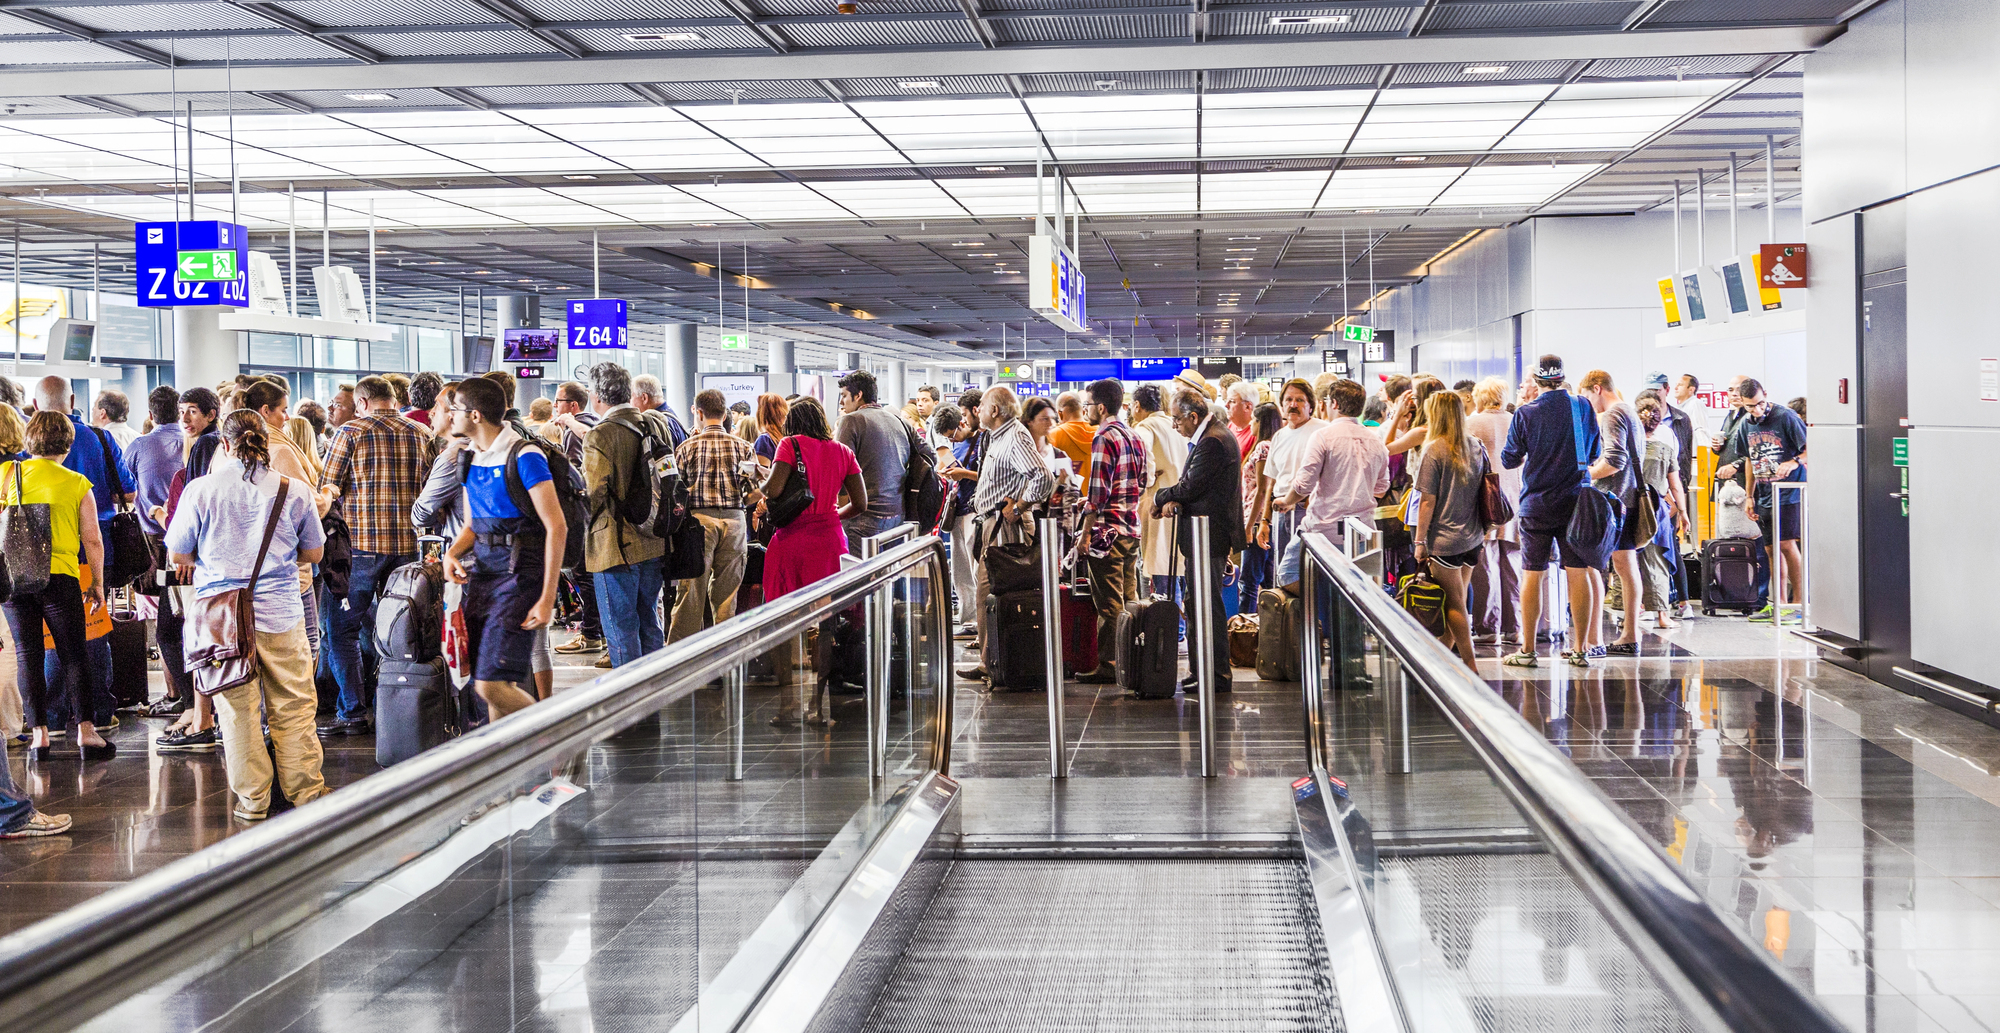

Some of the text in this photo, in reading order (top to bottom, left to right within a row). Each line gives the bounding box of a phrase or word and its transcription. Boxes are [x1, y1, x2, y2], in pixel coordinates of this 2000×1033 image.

[148, 267, 209, 299] Z 62
[574, 326, 612, 346] Z 64
[529, 368, 540, 376] LG
[730, 383, 755, 392] Turkey
